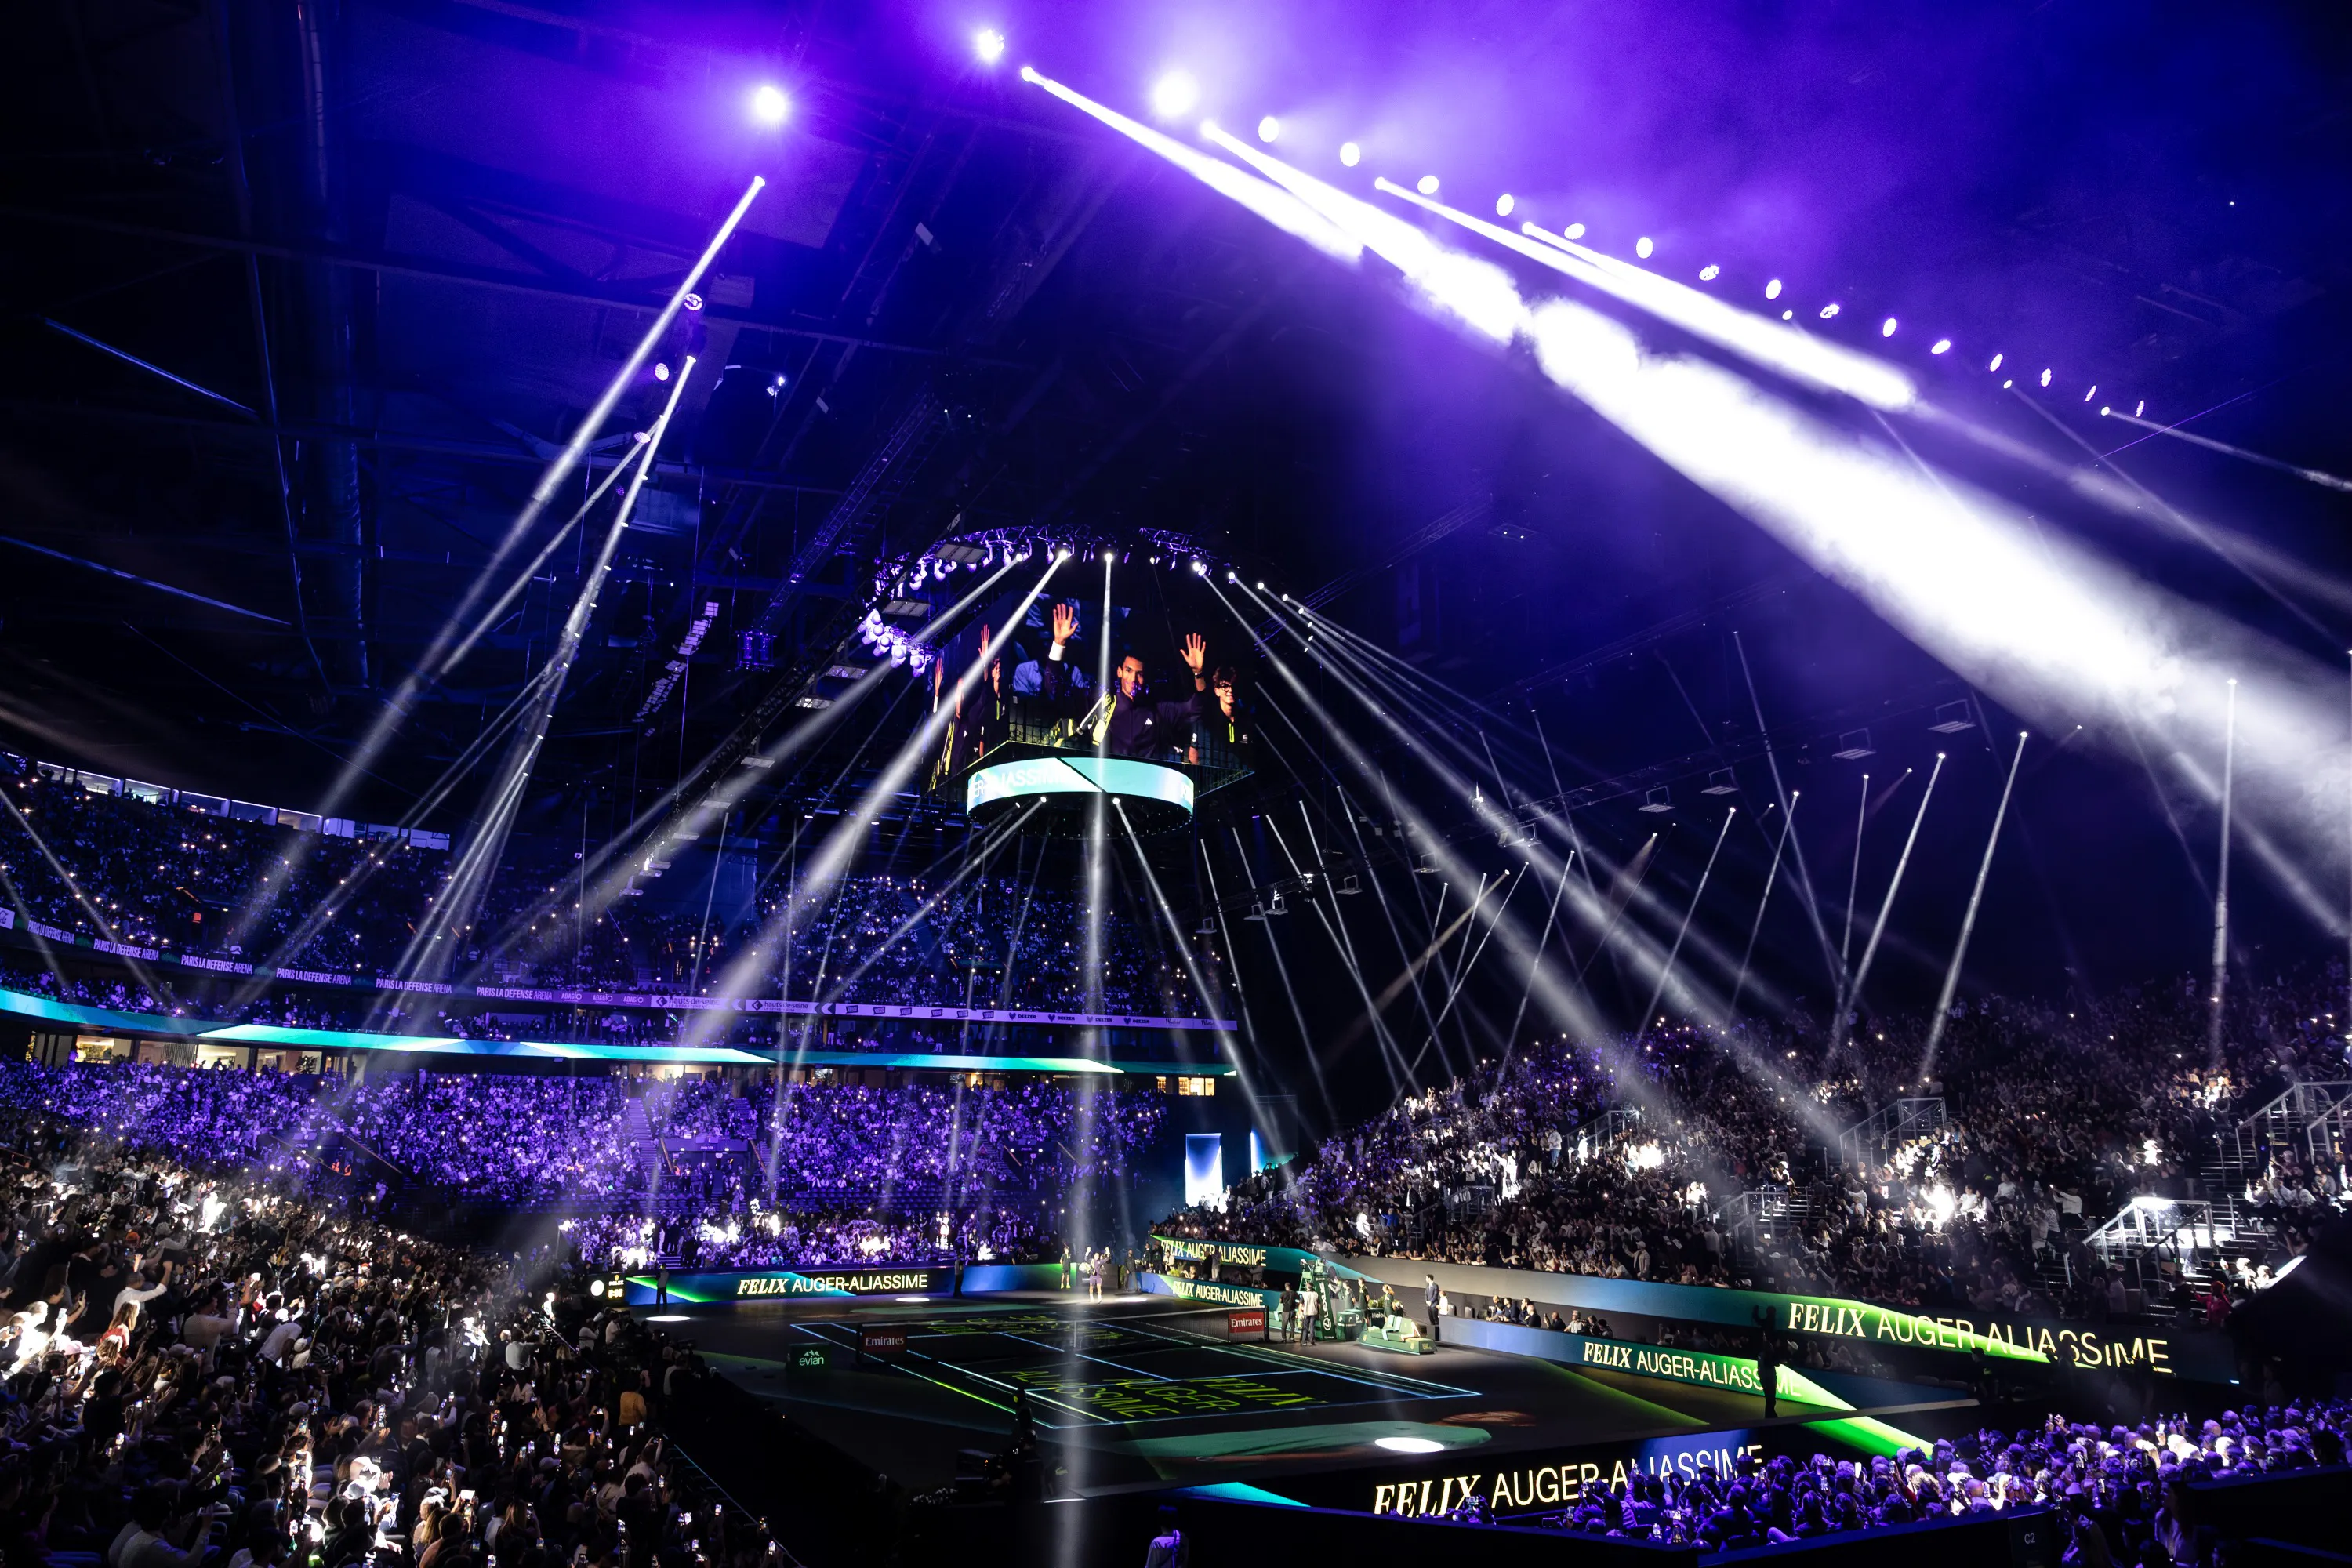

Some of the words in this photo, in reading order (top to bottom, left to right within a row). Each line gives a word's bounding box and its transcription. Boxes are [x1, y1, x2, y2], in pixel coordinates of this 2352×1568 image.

[181, 955, 198, 967] PARIS
[234, 964, 253, 975] ARENA
[277, 967, 296, 979] PARIS
[332, 975, 352, 985] ARENA
[376, 978, 394, 989] PARIS
[433, 983, 452, 994] ARENA
[477, 987, 495, 996] PARIS
[533, 991, 553, 1000] ARENA
[737, 1279, 789, 1294] FELIX
[792, 1275, 928, 1293] AUGER-ALIASSIME
[1173, 1281, 1195, 1298] FELIX
[1196, 1284, 1264, 1307] AUGER-ALIASSIME
[1231, 1318, 1263, 1328] Emirates
[1788, 1301, 1867, 1338] FELIX
[866, 1336, 905, 1347] Emirates
[799, 1356, 825, 1366] evian
[1584, 1341, 1632, 1368] FELIX
[1636, 1350, 1802, 1397] AUGER-ALIASSME
[1374, 1475, 1481, 1519] FELIX
